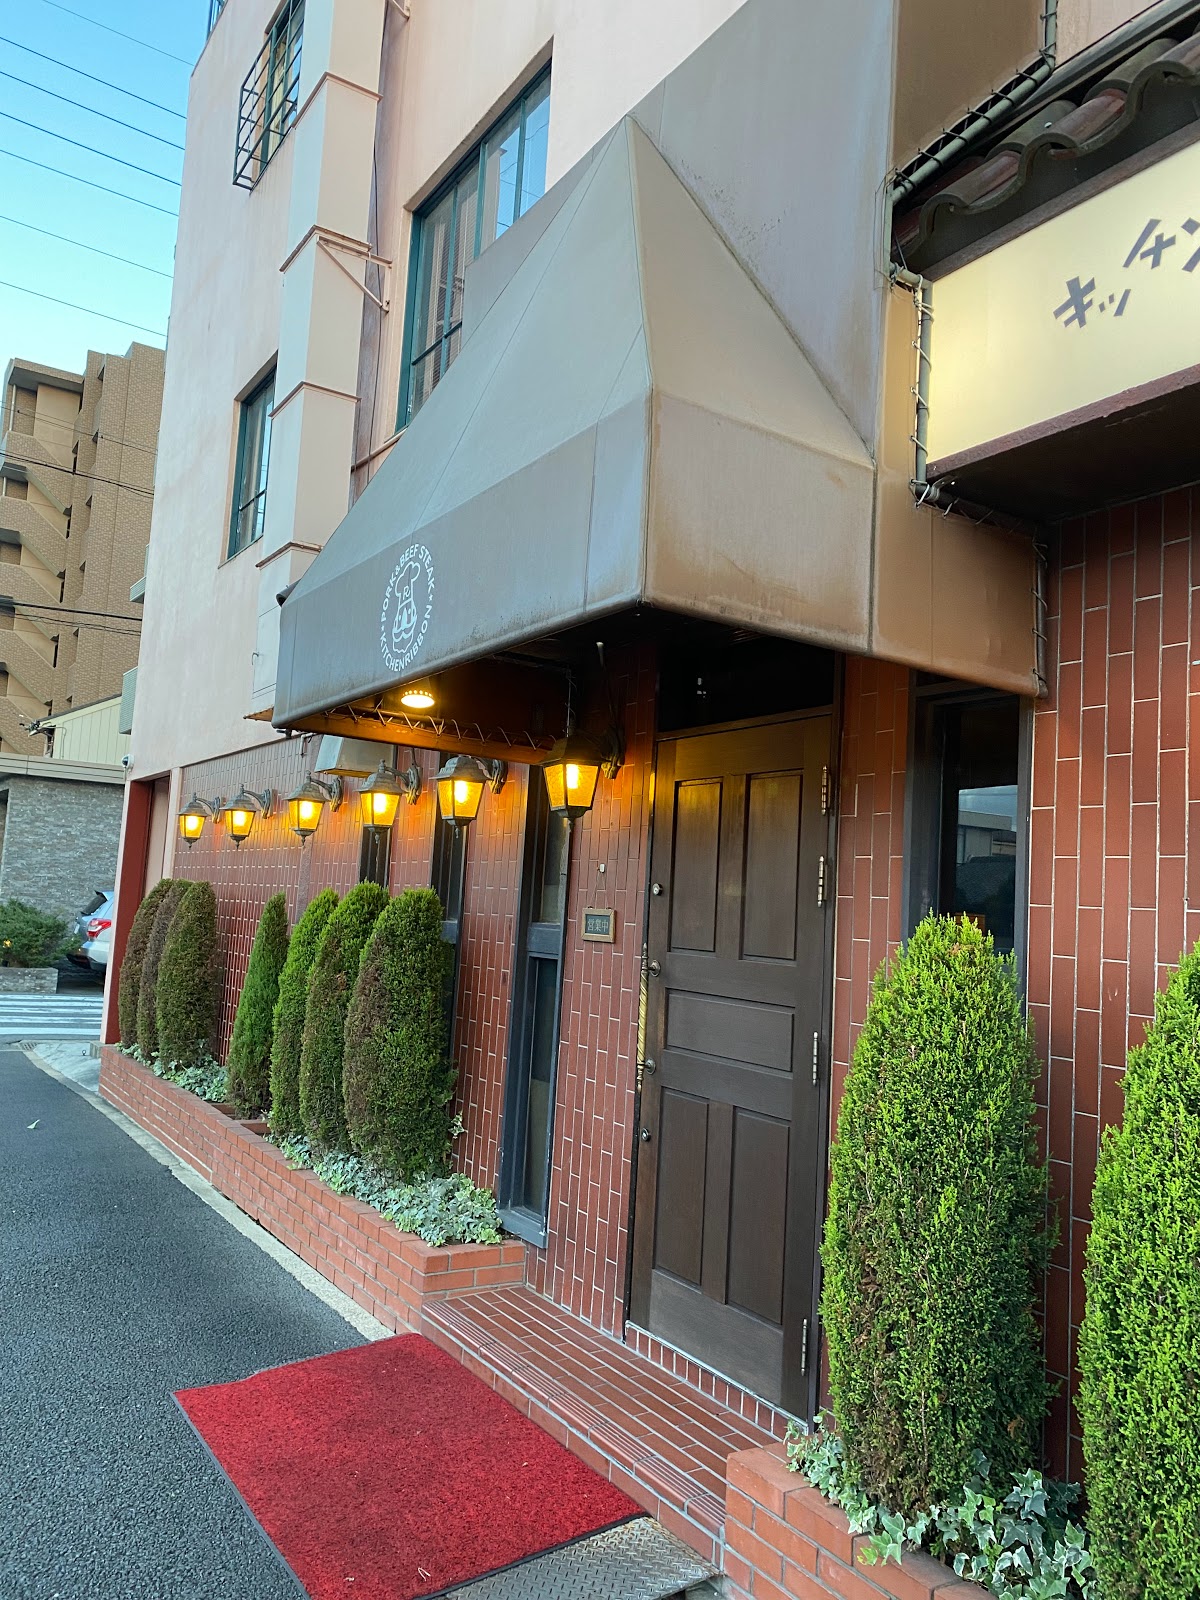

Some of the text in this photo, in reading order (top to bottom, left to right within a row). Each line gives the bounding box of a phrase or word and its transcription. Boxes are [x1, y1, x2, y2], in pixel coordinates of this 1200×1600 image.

[418, 544, 436, 594] STEAK
[587, 918, 609, 932] 営業中
